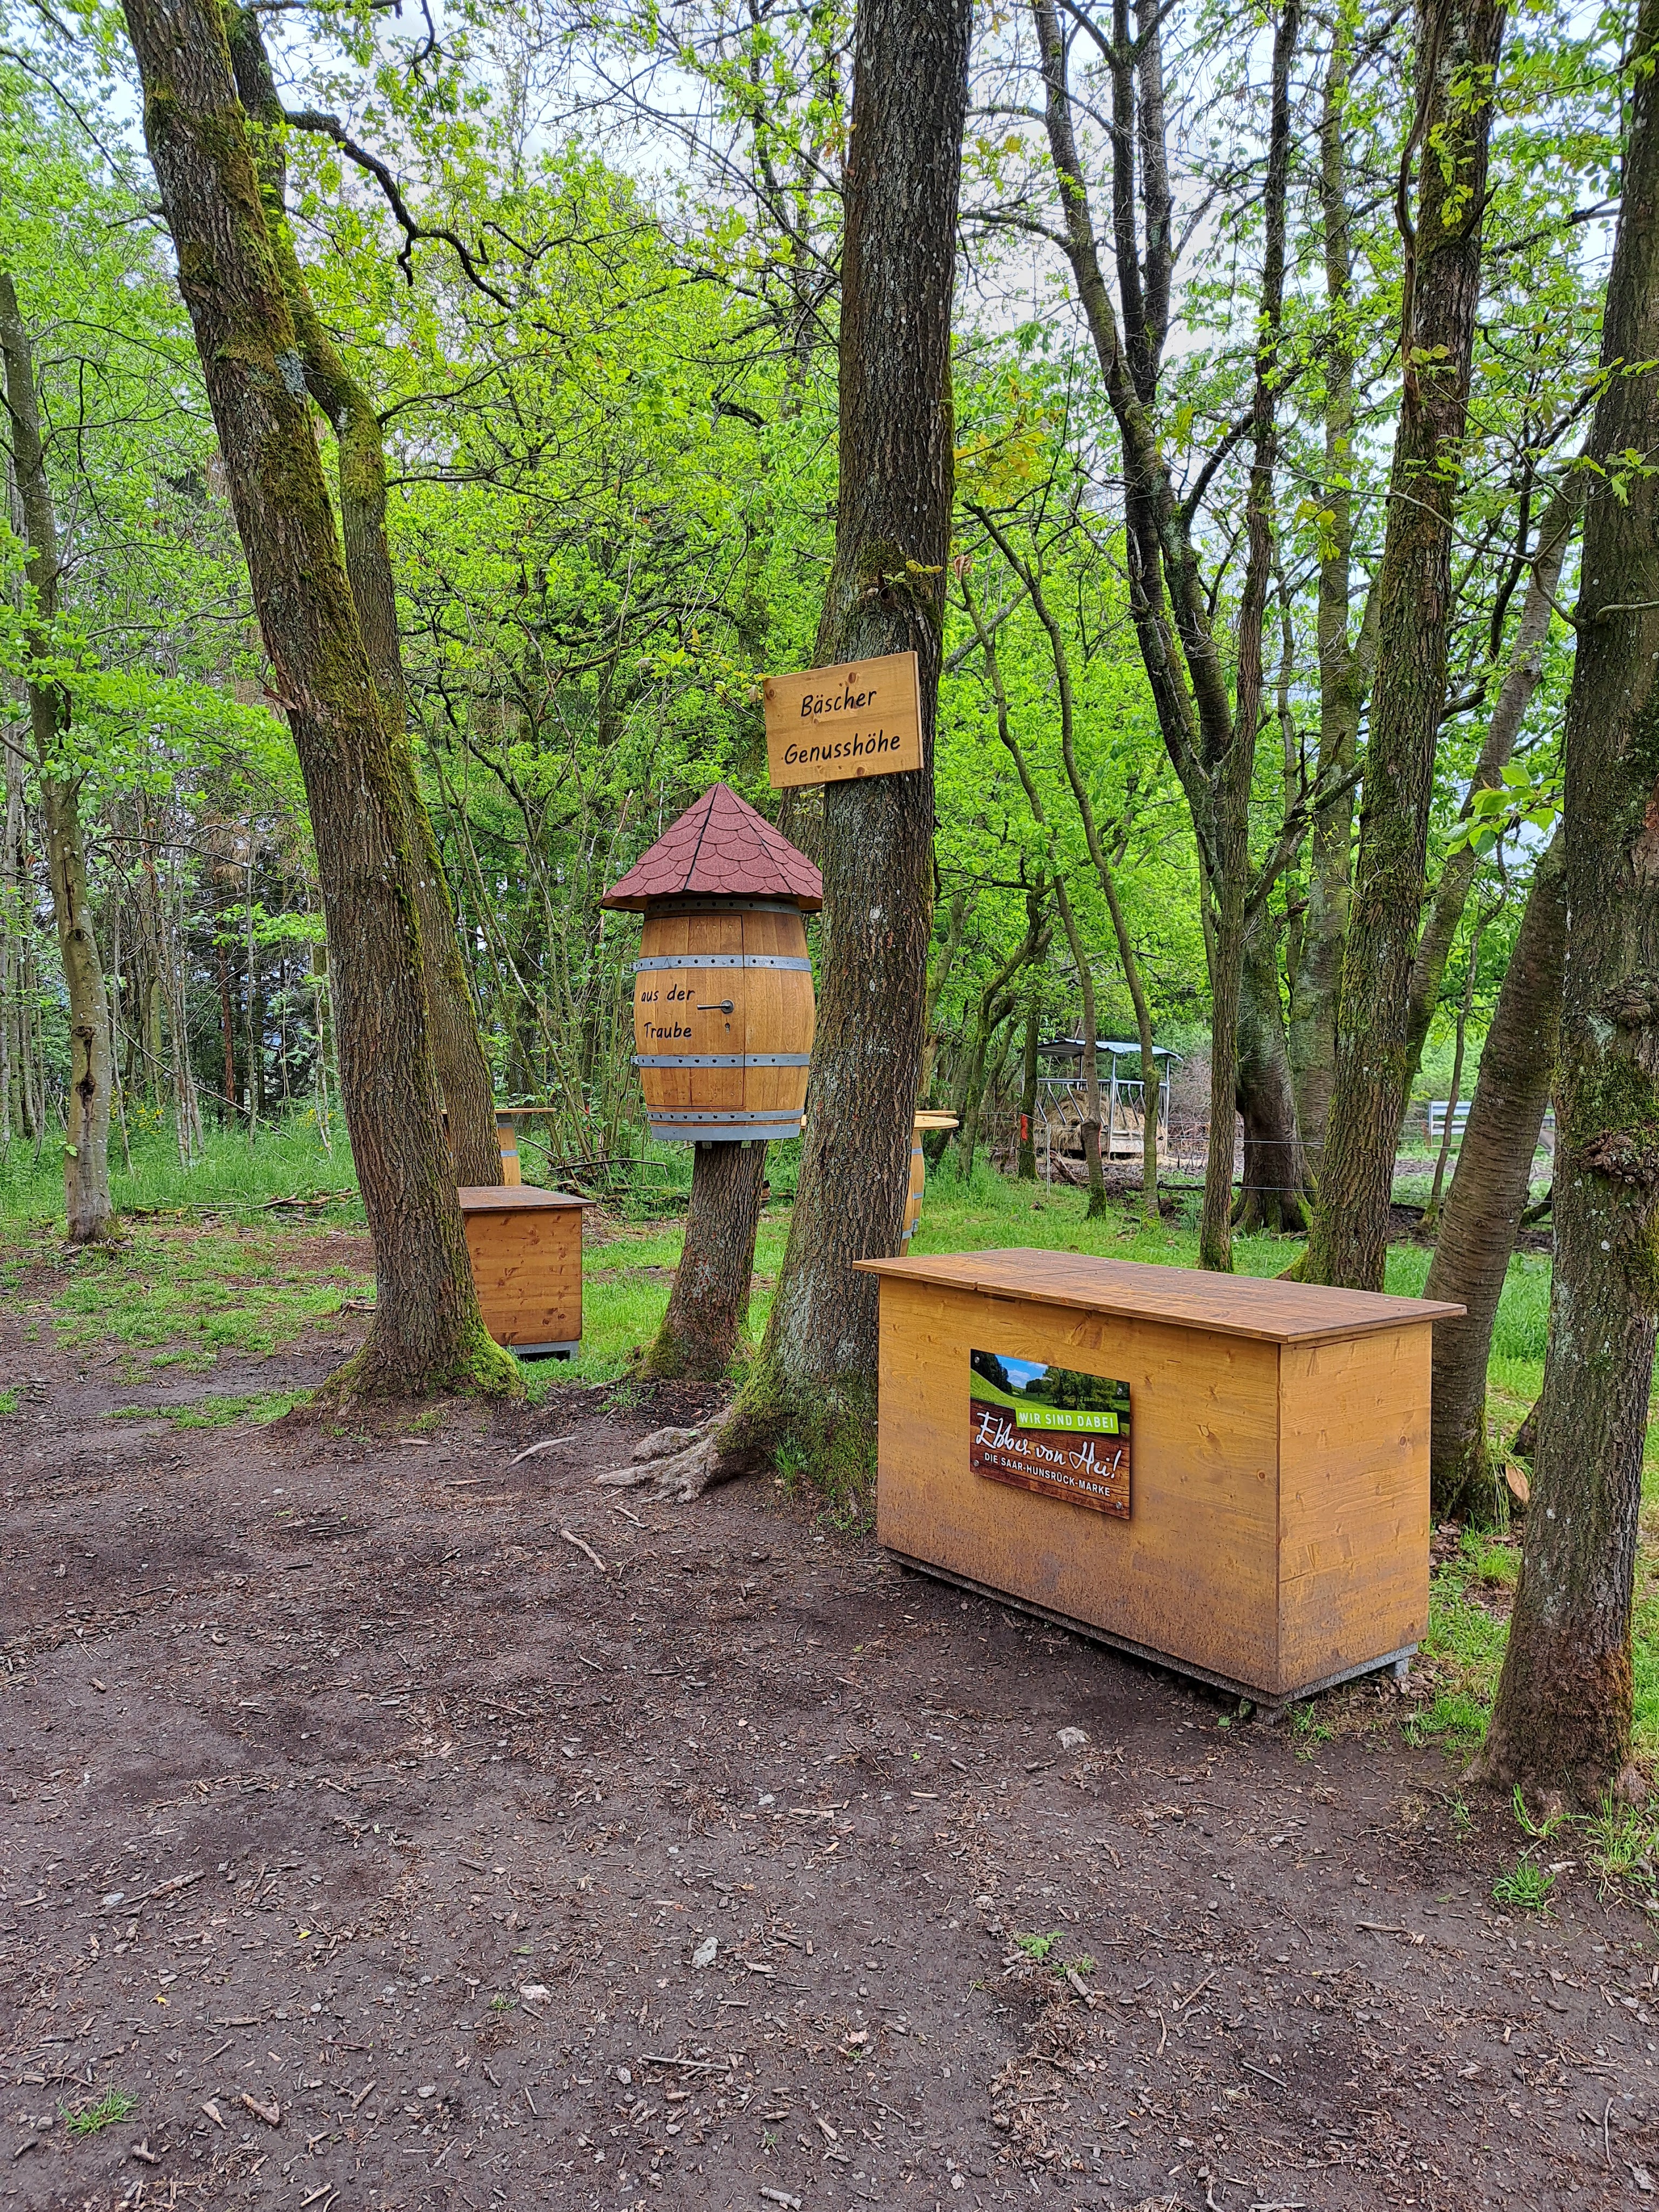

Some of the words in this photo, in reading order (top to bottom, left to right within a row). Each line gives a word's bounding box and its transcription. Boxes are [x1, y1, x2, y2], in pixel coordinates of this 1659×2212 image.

[801, 687, 876, 717] Bäscher
[784, 729, 900, 765] Genusshöhe
[641, 990, 659, 1002] aus
[667, 984, 695, 1000] der
[644, 1022, 692, 1038] Traube
[1019, 1412, 1041, 1425] WIR
[1045, 1413, 1072, 1426] SIND
[1077, 1415, 1114, 1429] DABEI
[976, 1412, 1031, 1455] Ebbes
[1035, 1445, 1066, 1465] von
[1069, 1441, 1122, 1479] Hei!
[984, 1452, 998, 1464] DIE
[1001, 1458, 1110, 1497] SAAR-HUNSRÜCK-MARKE
